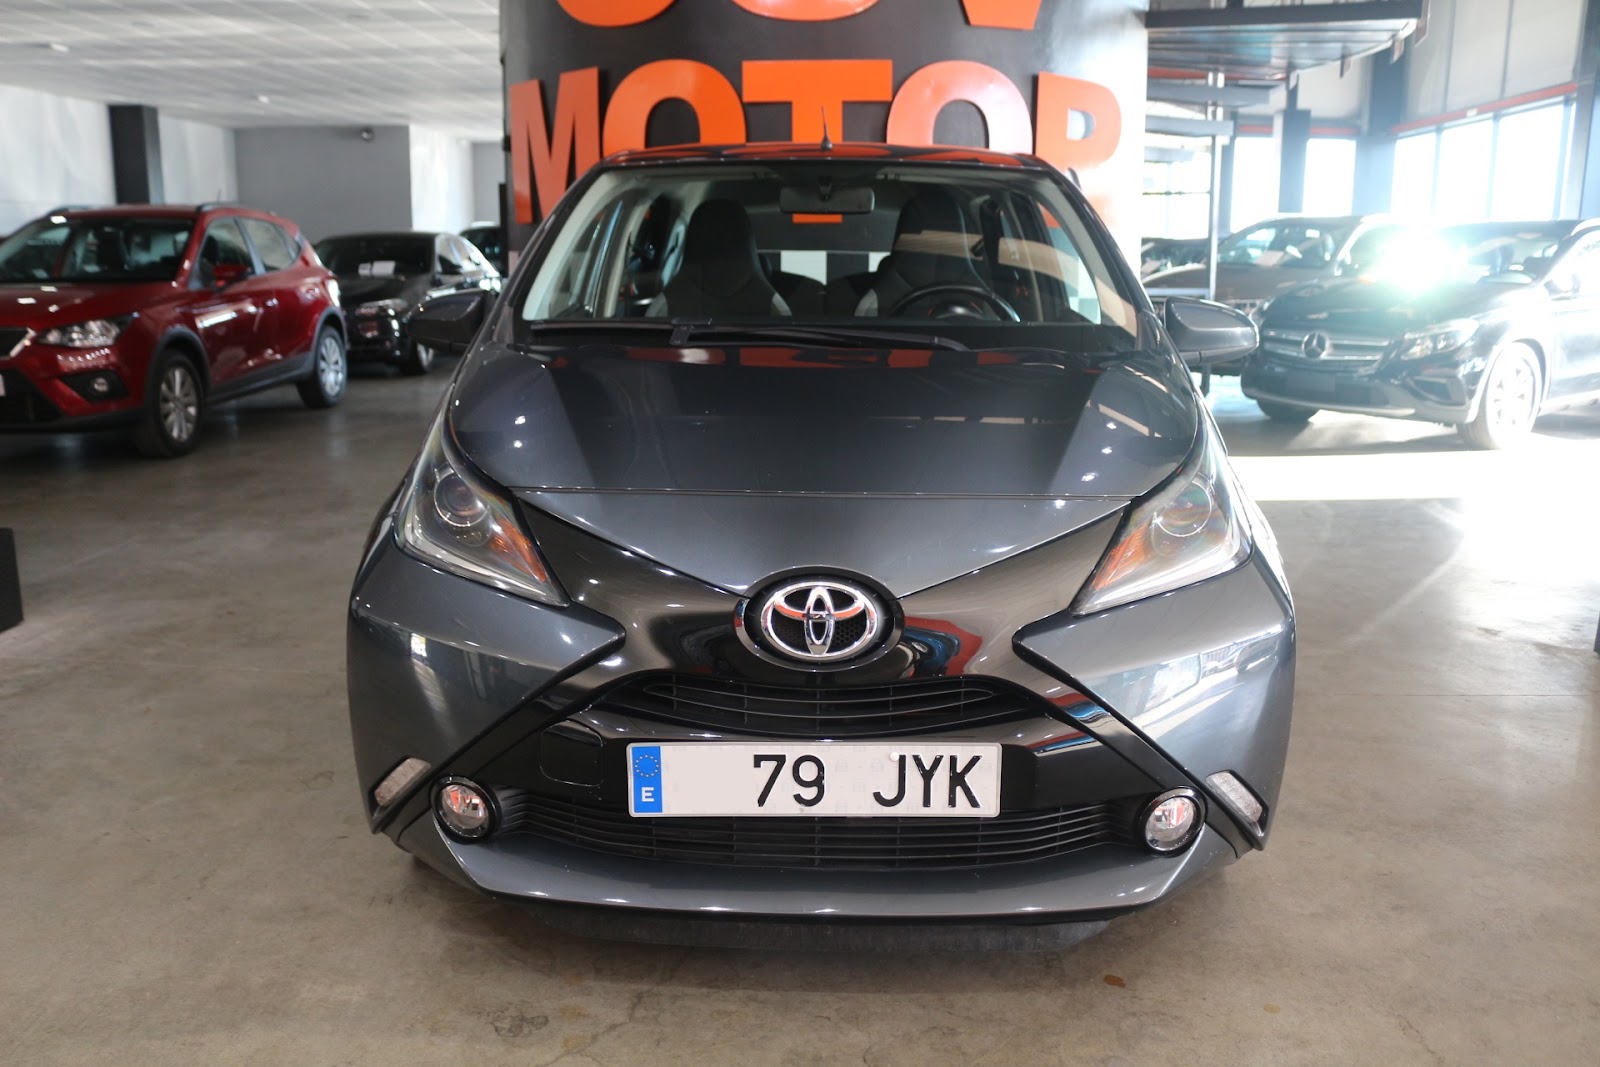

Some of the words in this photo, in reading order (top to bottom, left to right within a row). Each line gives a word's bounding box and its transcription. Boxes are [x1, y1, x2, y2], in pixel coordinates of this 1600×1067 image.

[641, 787, 654, 802] E
[753, 754, 825, 807] 79
[873, 754, 982, 808] JYK
